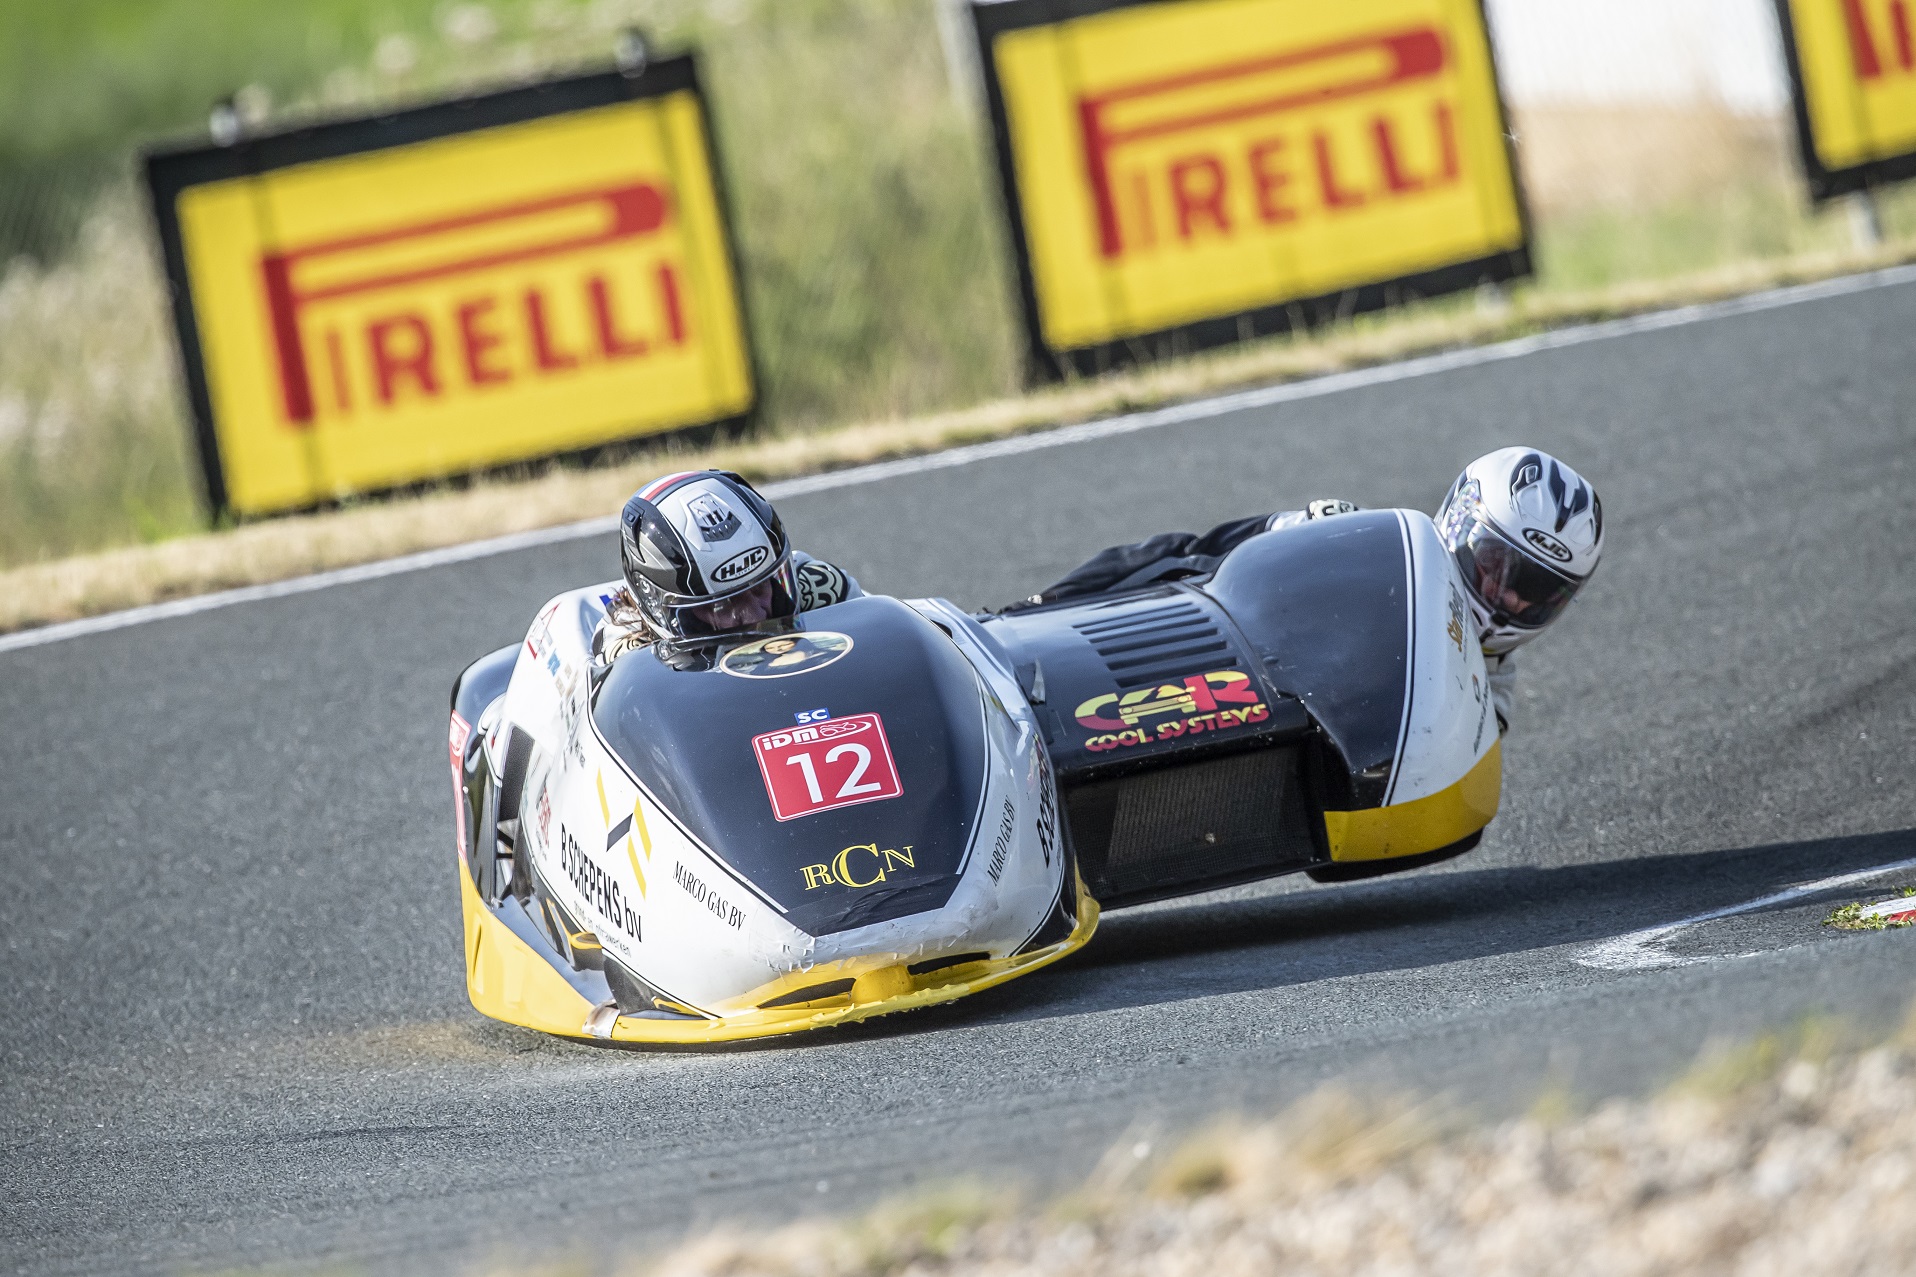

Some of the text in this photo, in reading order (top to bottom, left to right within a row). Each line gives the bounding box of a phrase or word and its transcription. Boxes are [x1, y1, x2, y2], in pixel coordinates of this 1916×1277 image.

[1078, 30, 1460, 260] PIRELLI
[259, 184, 690, 424] PIRELLI
[720, 548, 763, 580] HJC
[1529, 531, 1567, 558] HJC
[797, 709, 828, 724] SC
[1085, 703, 1270, 752] COOL SYSTEMS
[785, 742, 882, 804] 12
[561, 822, 567, 872] B
[568, 833, 622, 929] SCHEPENS
[800, 843, 916, 891] RCN
[672, 860, 747, 931] MARCO GAS BV
